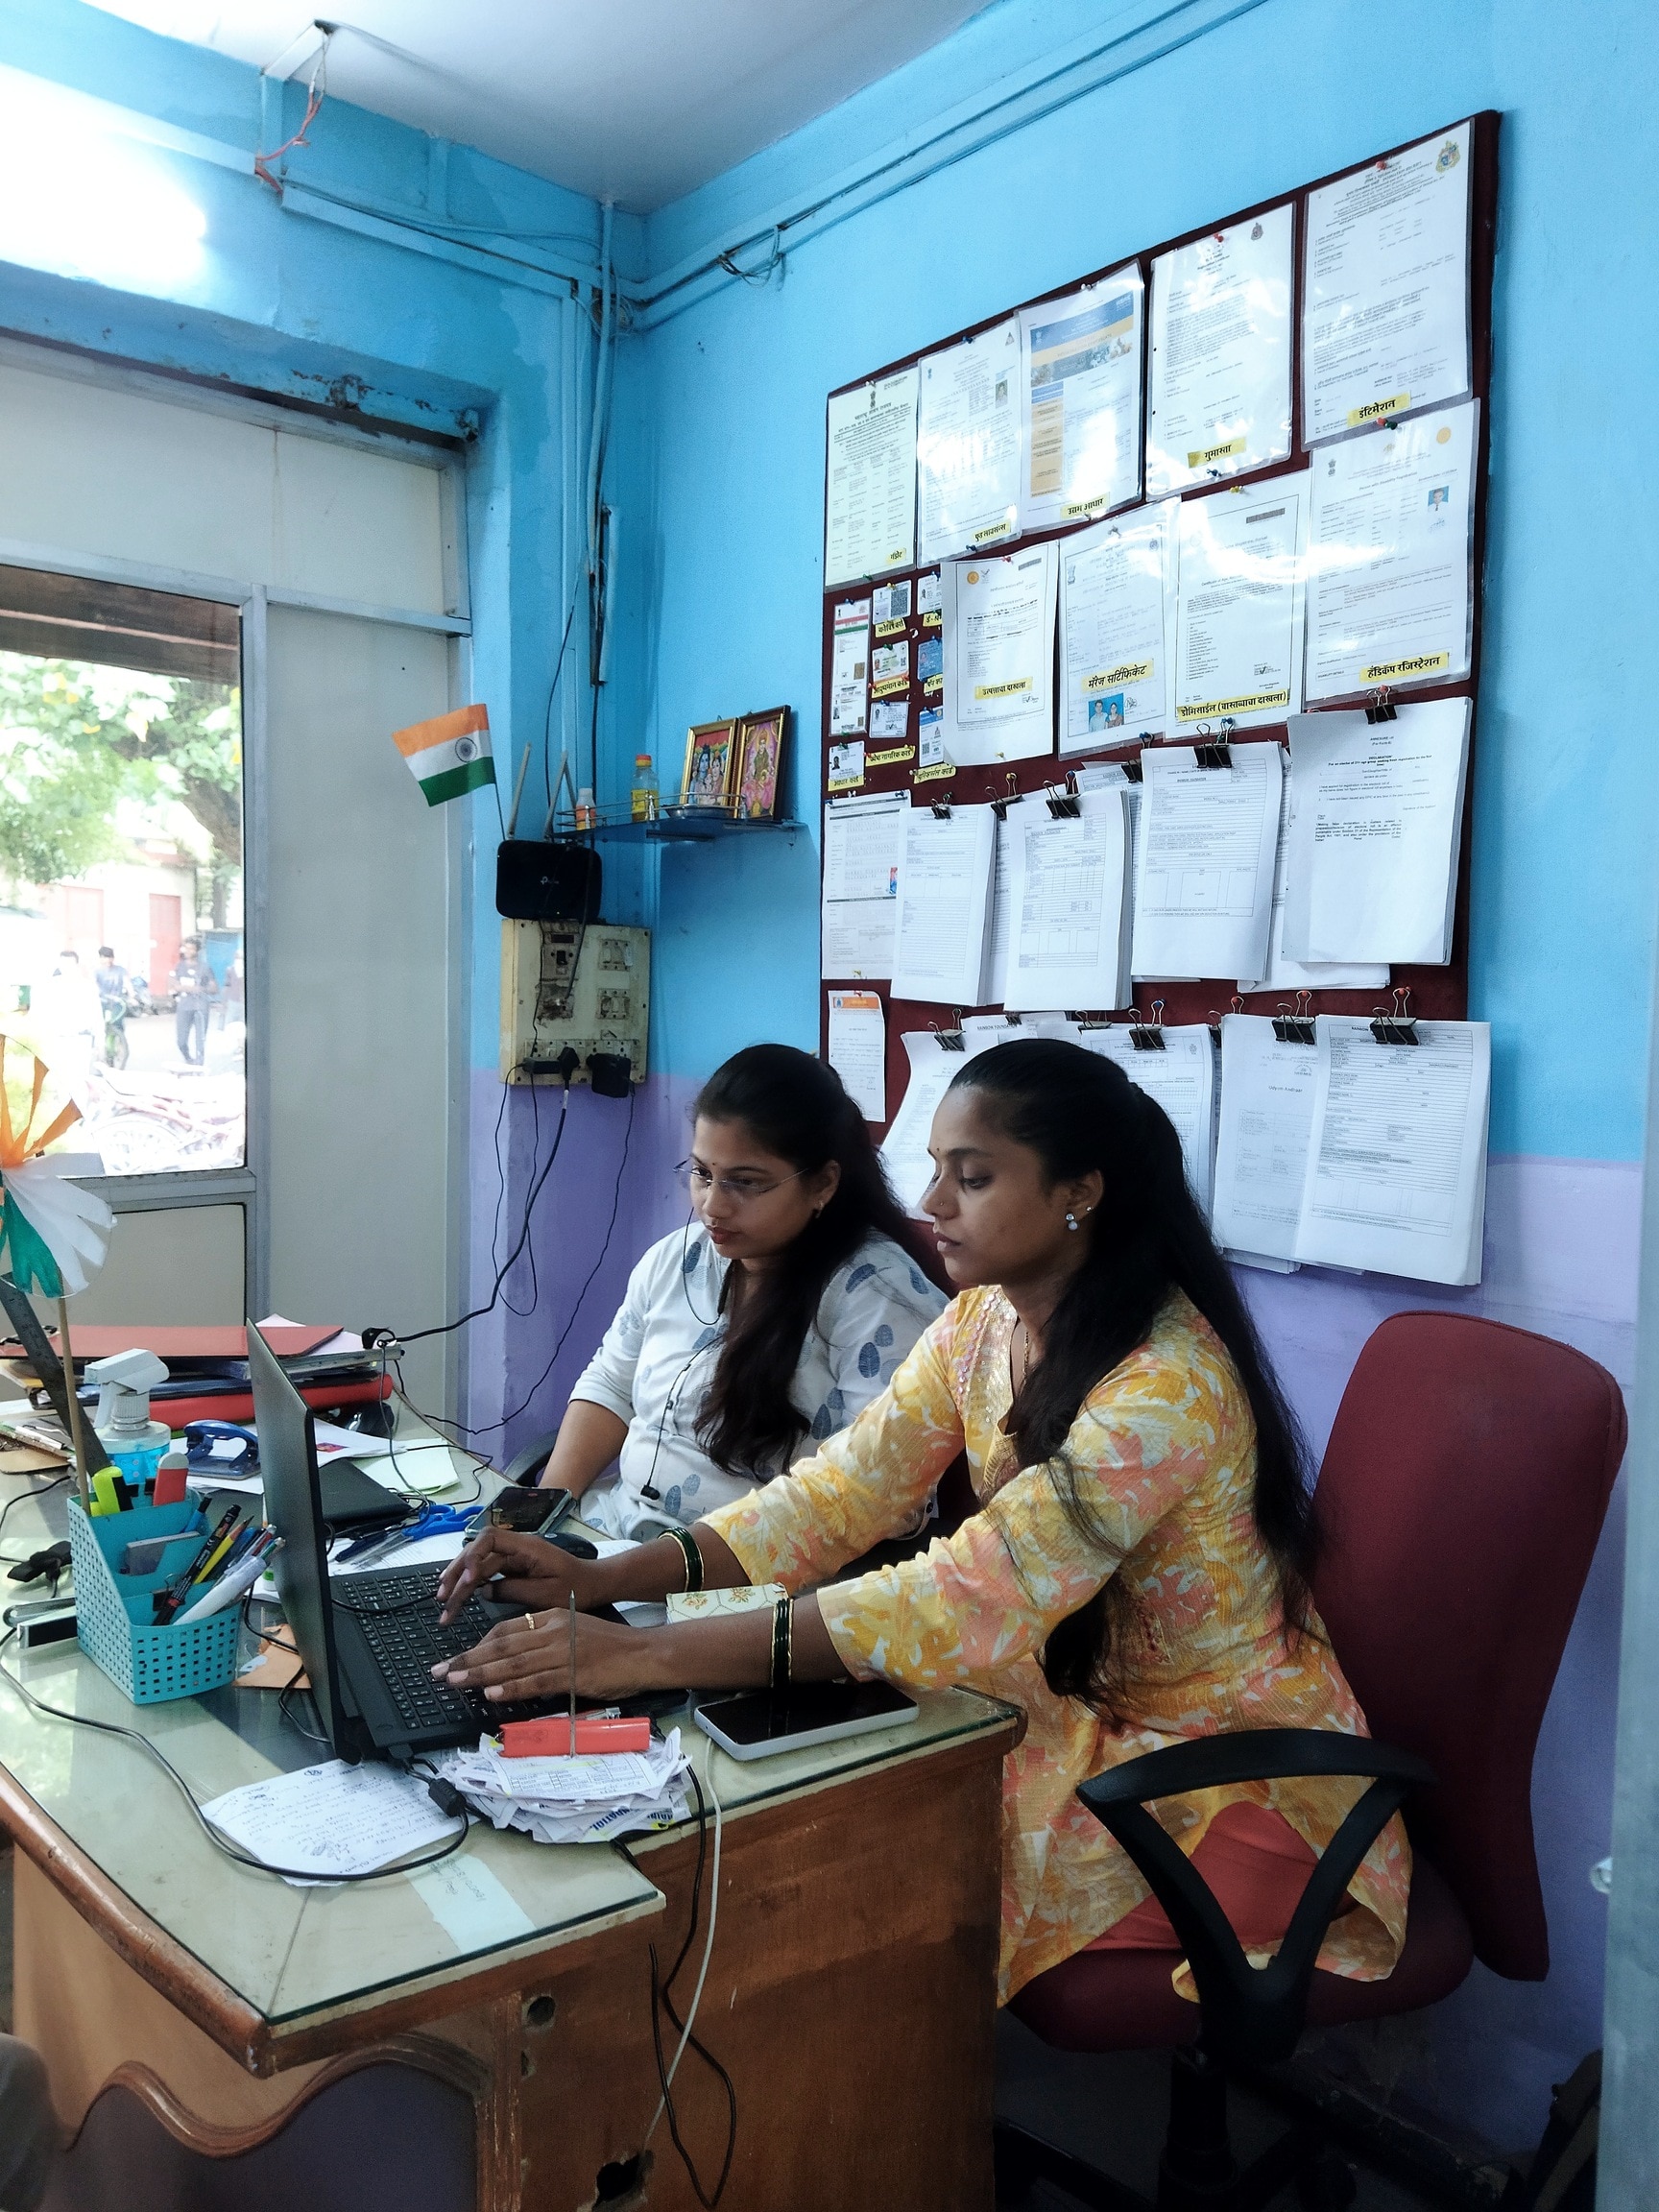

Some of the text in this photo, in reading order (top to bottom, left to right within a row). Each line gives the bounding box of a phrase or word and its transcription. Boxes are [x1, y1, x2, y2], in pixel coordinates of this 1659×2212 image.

[1358, 399, 1396, 419] इंटिमेशन
[1204, 445, 1232, 462] गुमास्ता
[1084, 498, 1104, 511] आधार
[1397, 657, 1441, 672] रजिस्ट्रेशन
[1106, 664, 1147, 685] सर्टिफिकेट
[1181, 703, 1215, 717] डोमिसाईल
